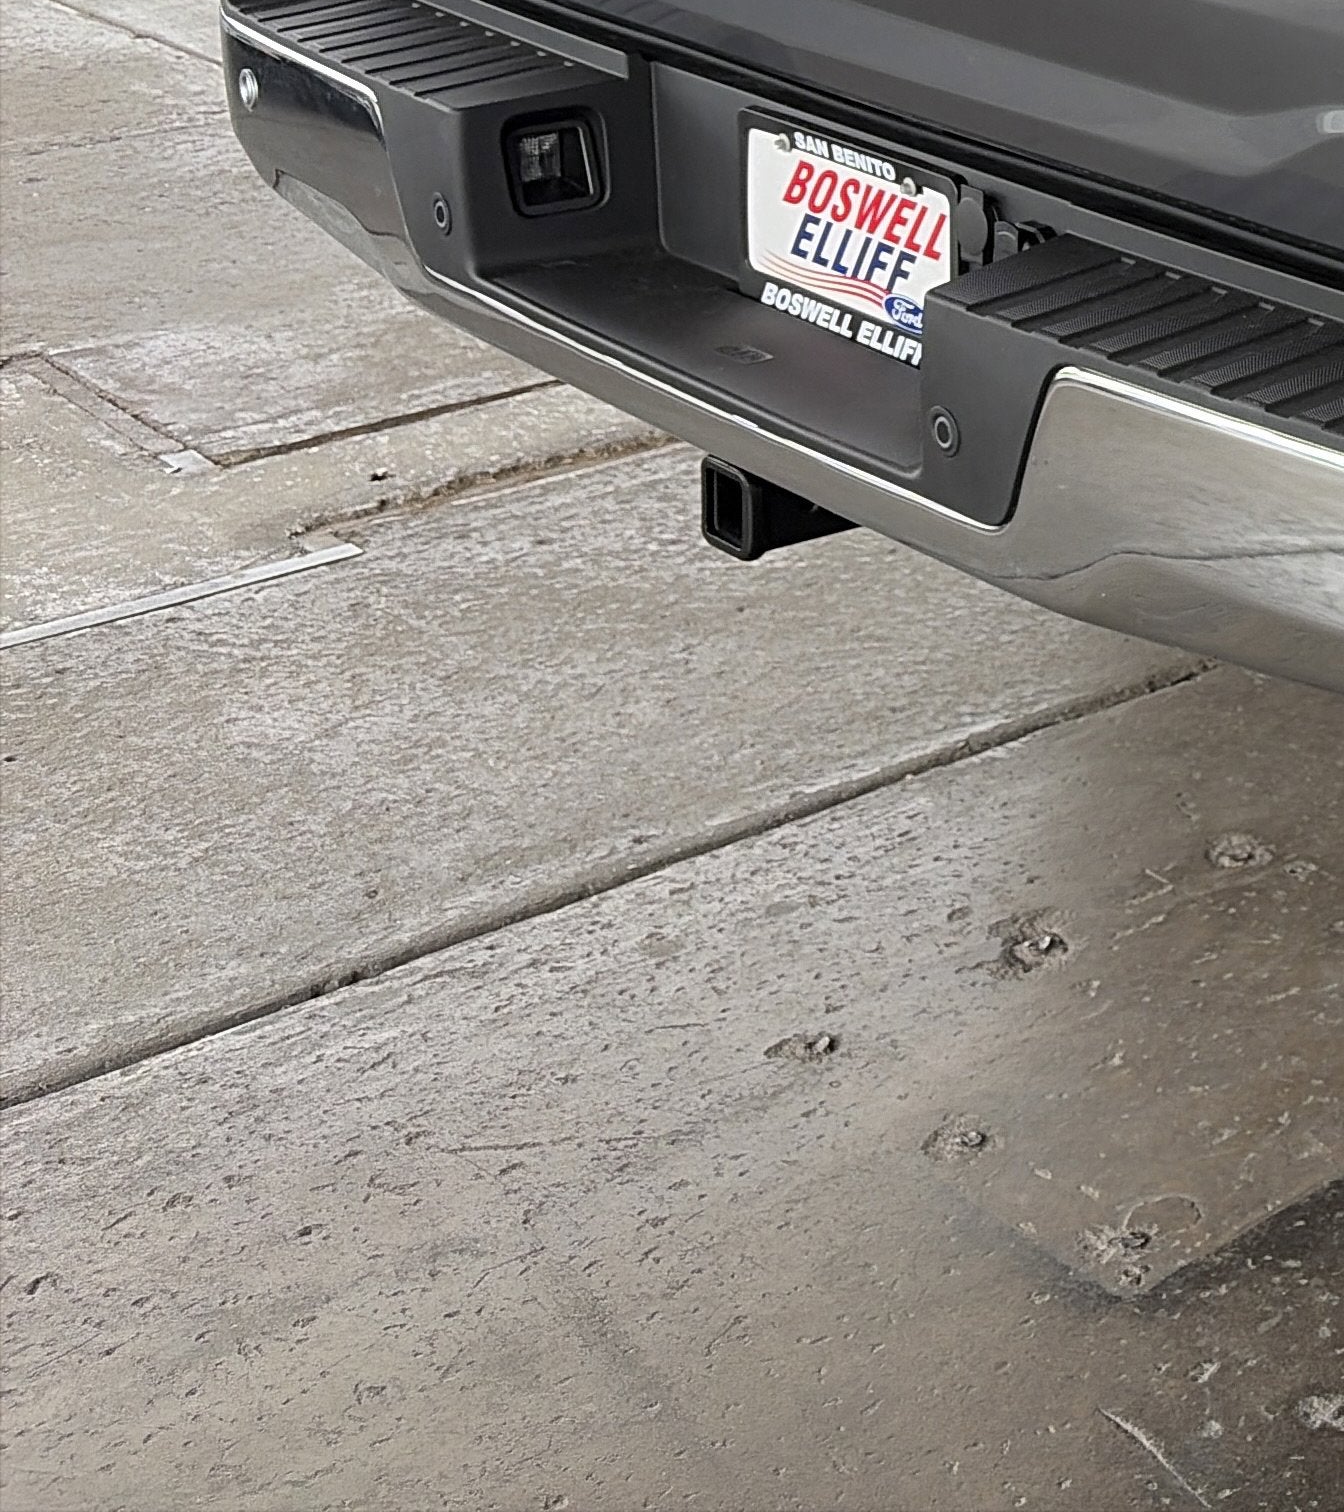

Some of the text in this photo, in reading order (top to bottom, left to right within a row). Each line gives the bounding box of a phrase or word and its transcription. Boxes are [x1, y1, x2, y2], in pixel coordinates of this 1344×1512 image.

[793, 131, 896, 181] SAN BENITO
[783, 160, 948, 261] BOSWELL
[790, 213, 917, 292] ELLIFF
[761, 282, 853, 338] BOSWELL
[891, 297, 923, 328] Ford
